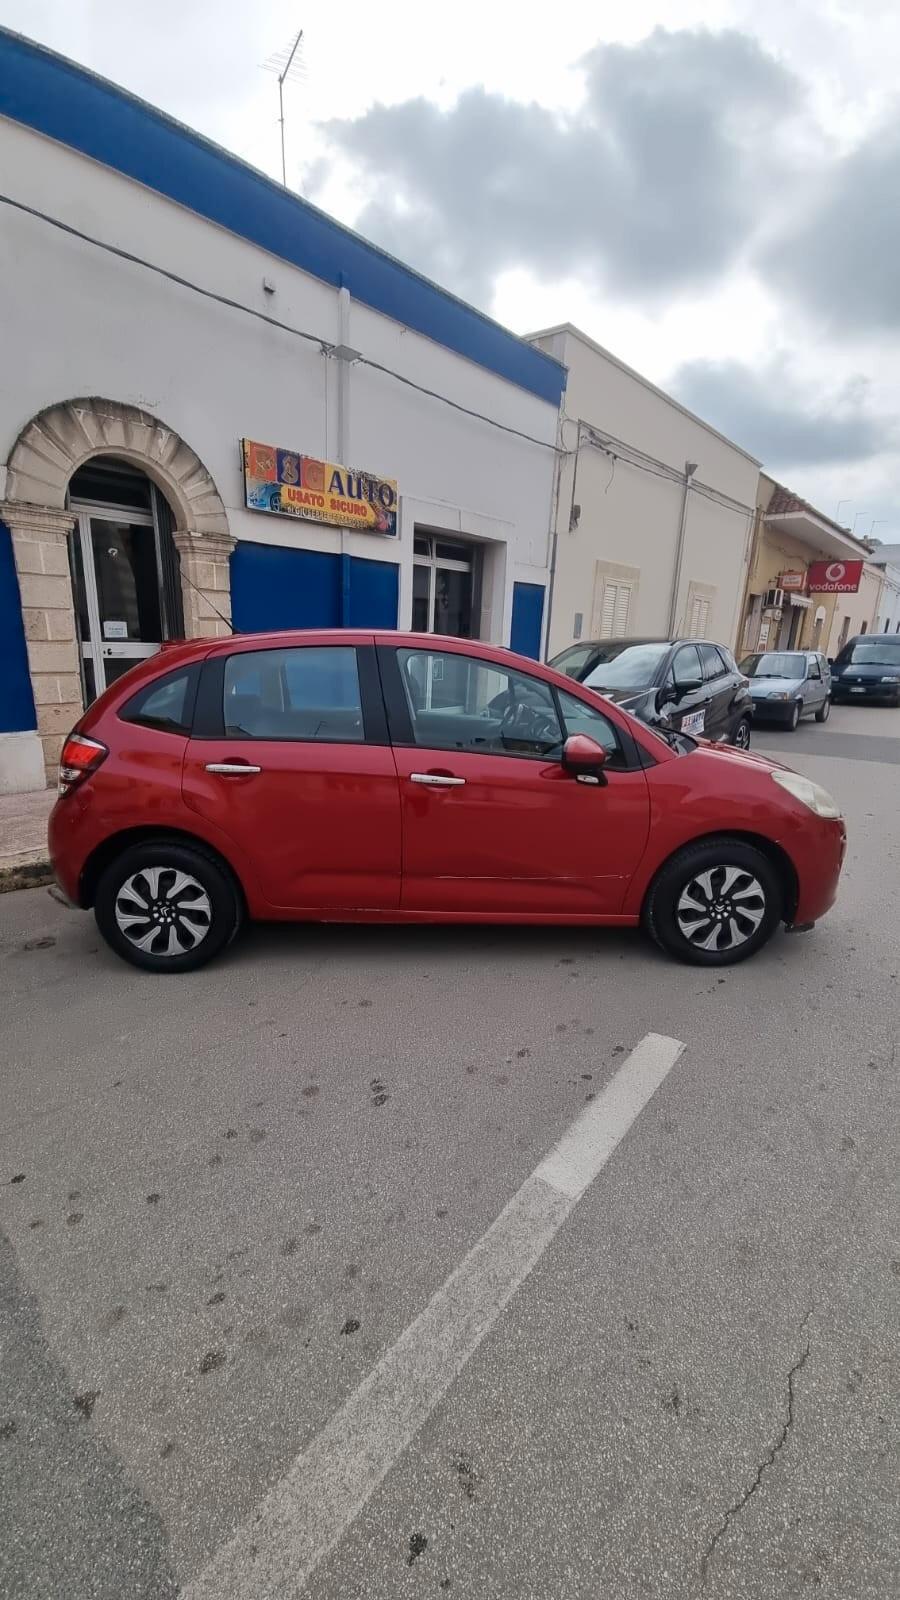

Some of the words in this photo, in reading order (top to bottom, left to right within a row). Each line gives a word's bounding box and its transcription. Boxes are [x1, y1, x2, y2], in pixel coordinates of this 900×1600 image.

[288, 488, 324, 508] USATO
[330, 498, 368, 516] SICURO
[328, 470, 394, 507] AUTO
[809, 582, 857, 591] vodafone
